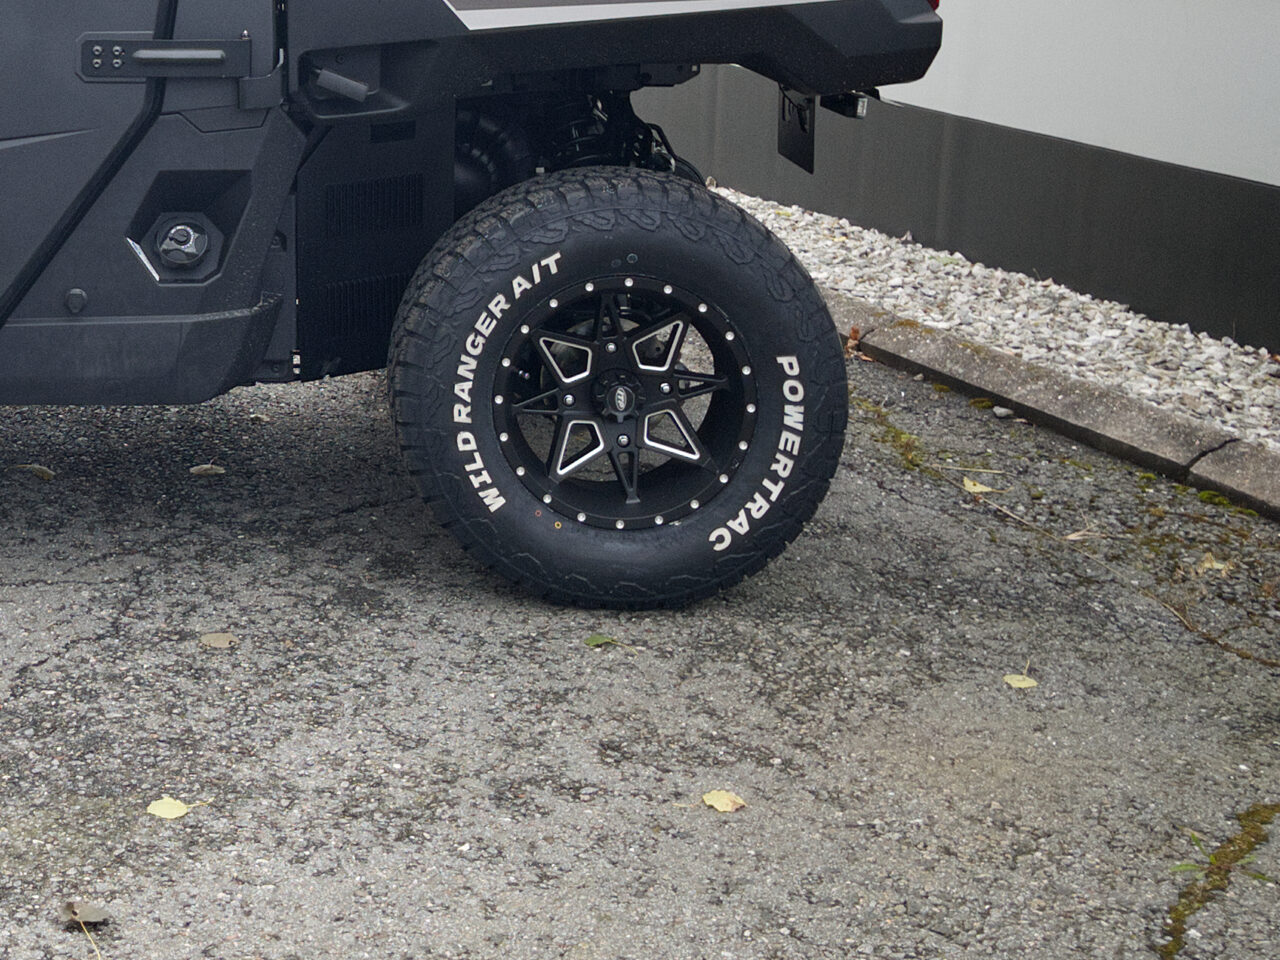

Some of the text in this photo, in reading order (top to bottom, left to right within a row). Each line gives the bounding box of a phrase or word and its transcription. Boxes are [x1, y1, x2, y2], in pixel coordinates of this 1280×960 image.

[453, 251, 562, 513] WILD RANGER A/T
[708, 355, 805, 552] POWERTRAC
